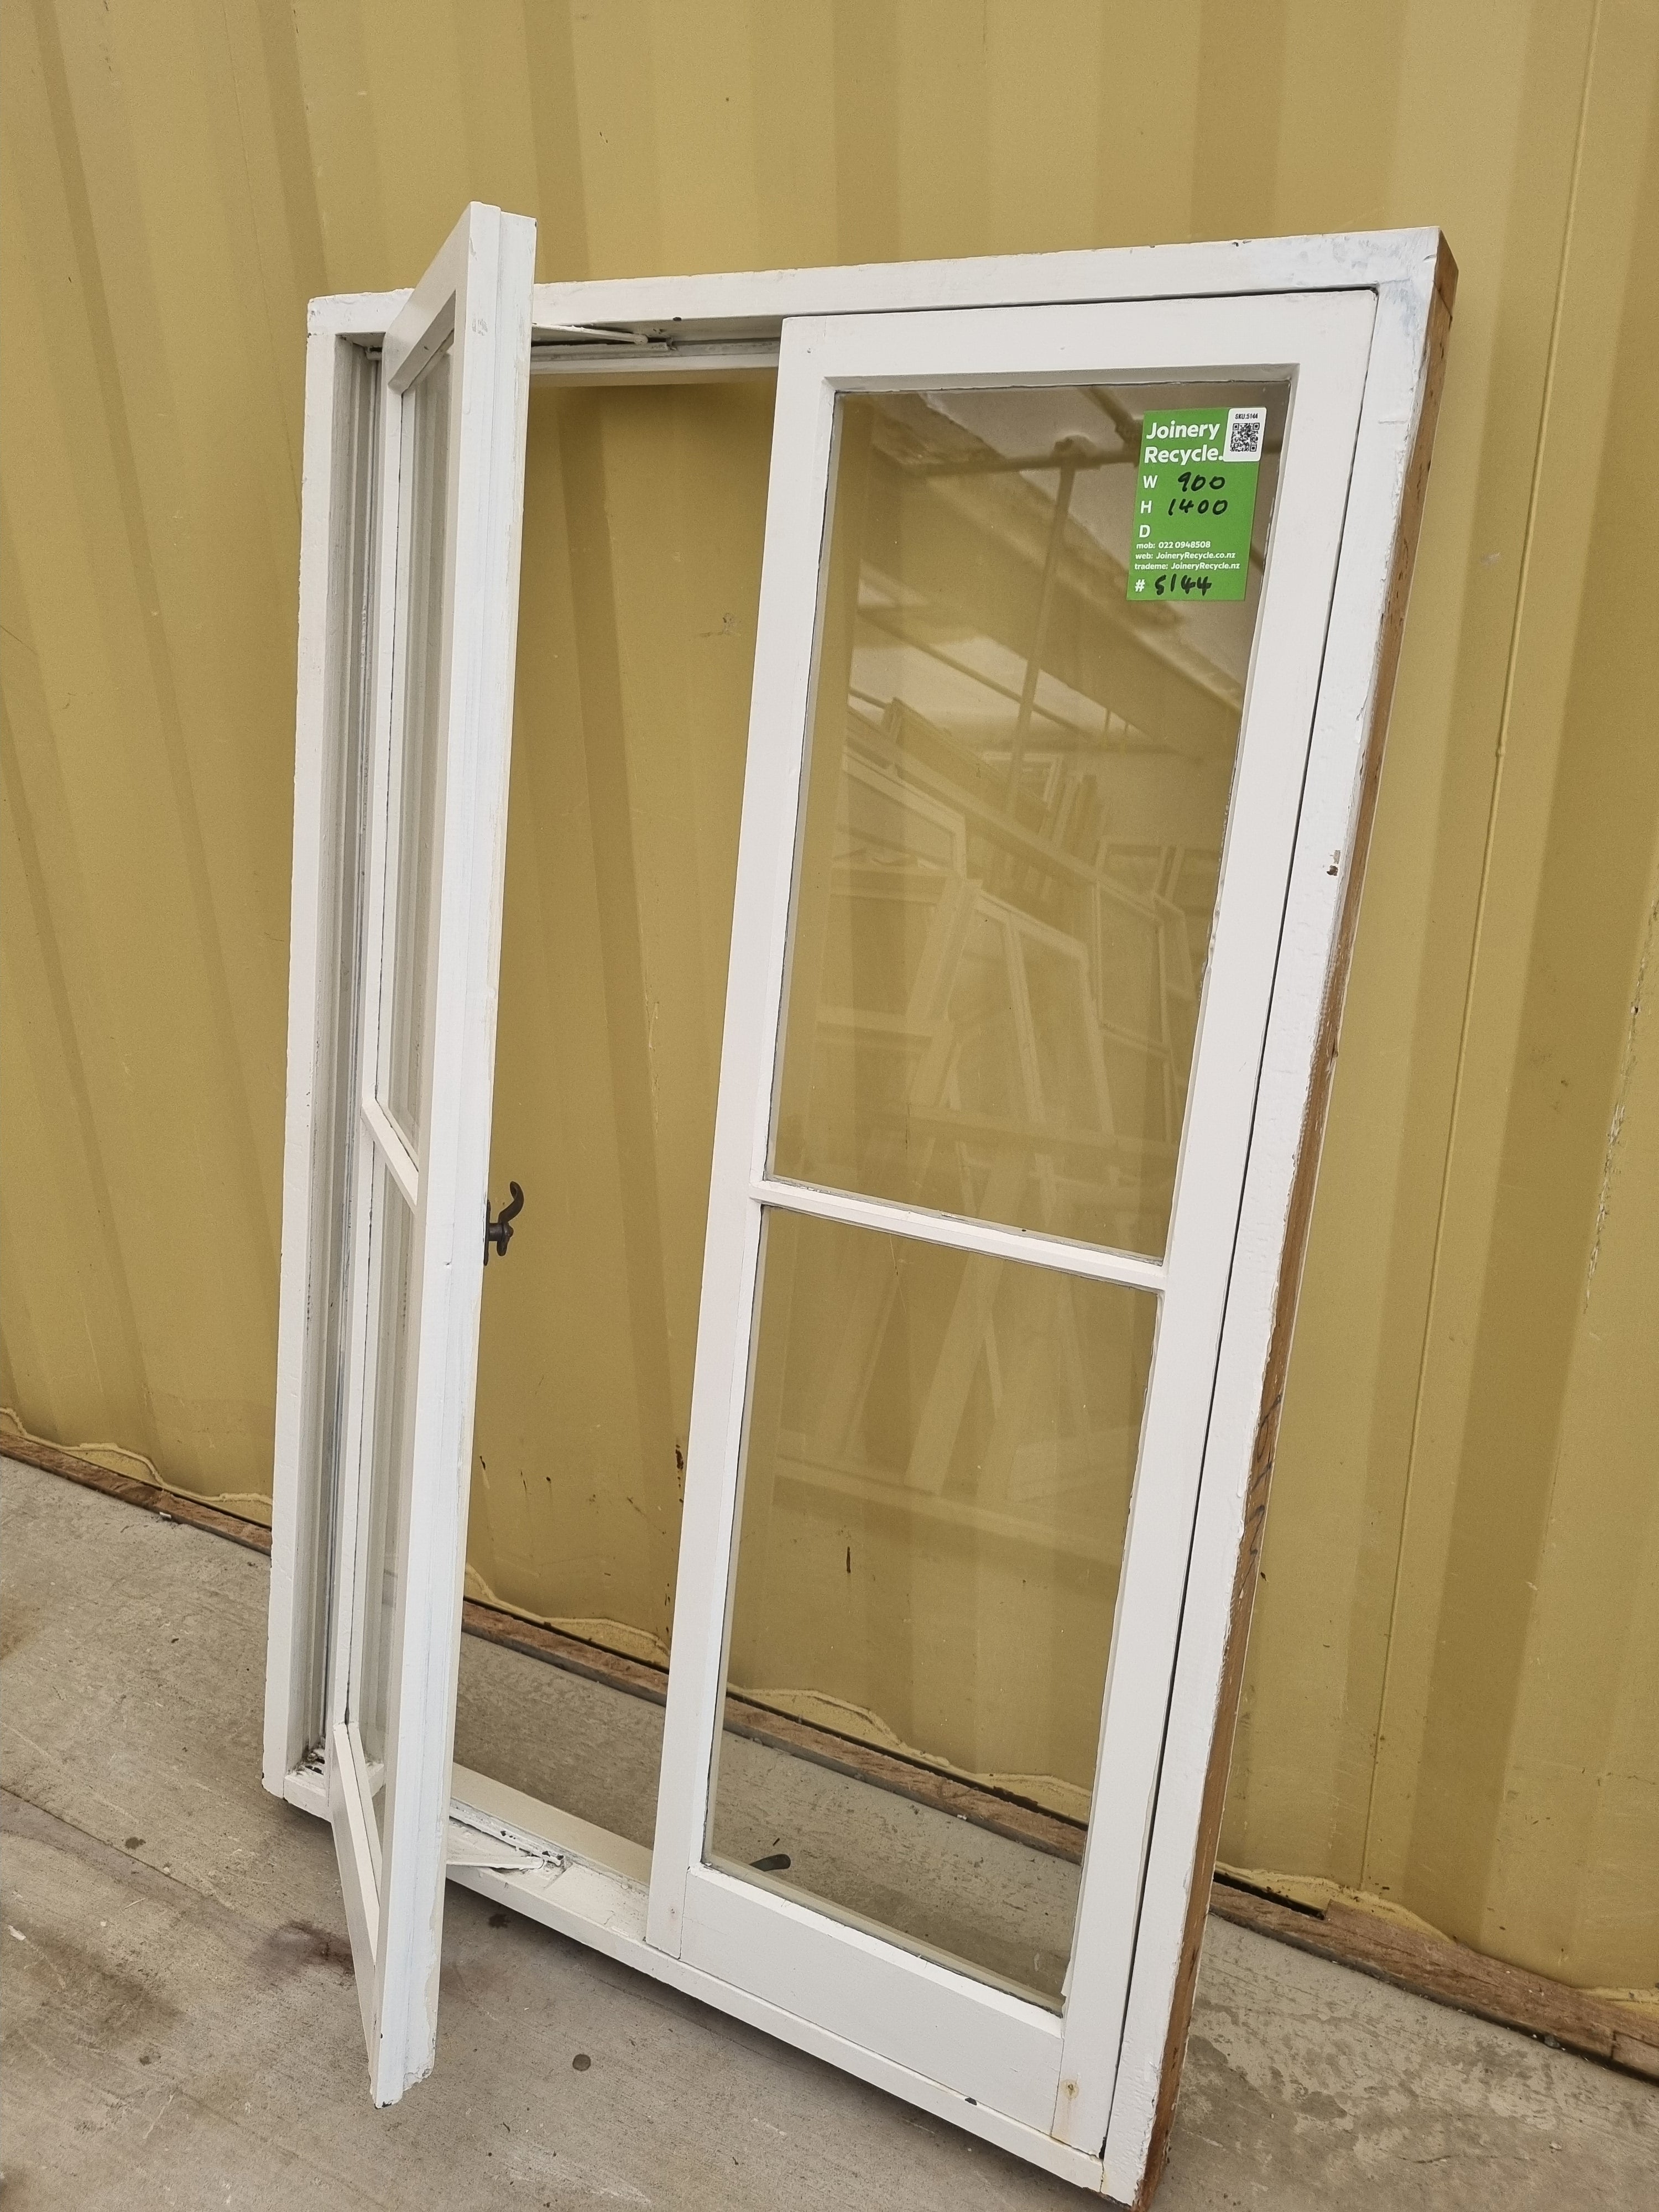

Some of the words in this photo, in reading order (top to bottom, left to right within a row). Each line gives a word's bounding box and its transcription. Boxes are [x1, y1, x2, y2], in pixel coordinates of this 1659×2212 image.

[1146, 420, 1220, 440] Joinery
[1143, 475, 1158, 488] W
[1178, 472, 1225, 492] 900
[1140, 500, 1152, 514] H
[1168, 498, 1228, 515] 1400
[1139, 525, 1150, 538] D
[1156, 552, 1235, 561] JoineryRecycle.co.nz
[1171, 562, 1240, 571] JoineryRecycle.nz
[1135, 580, 1145, 592] #
